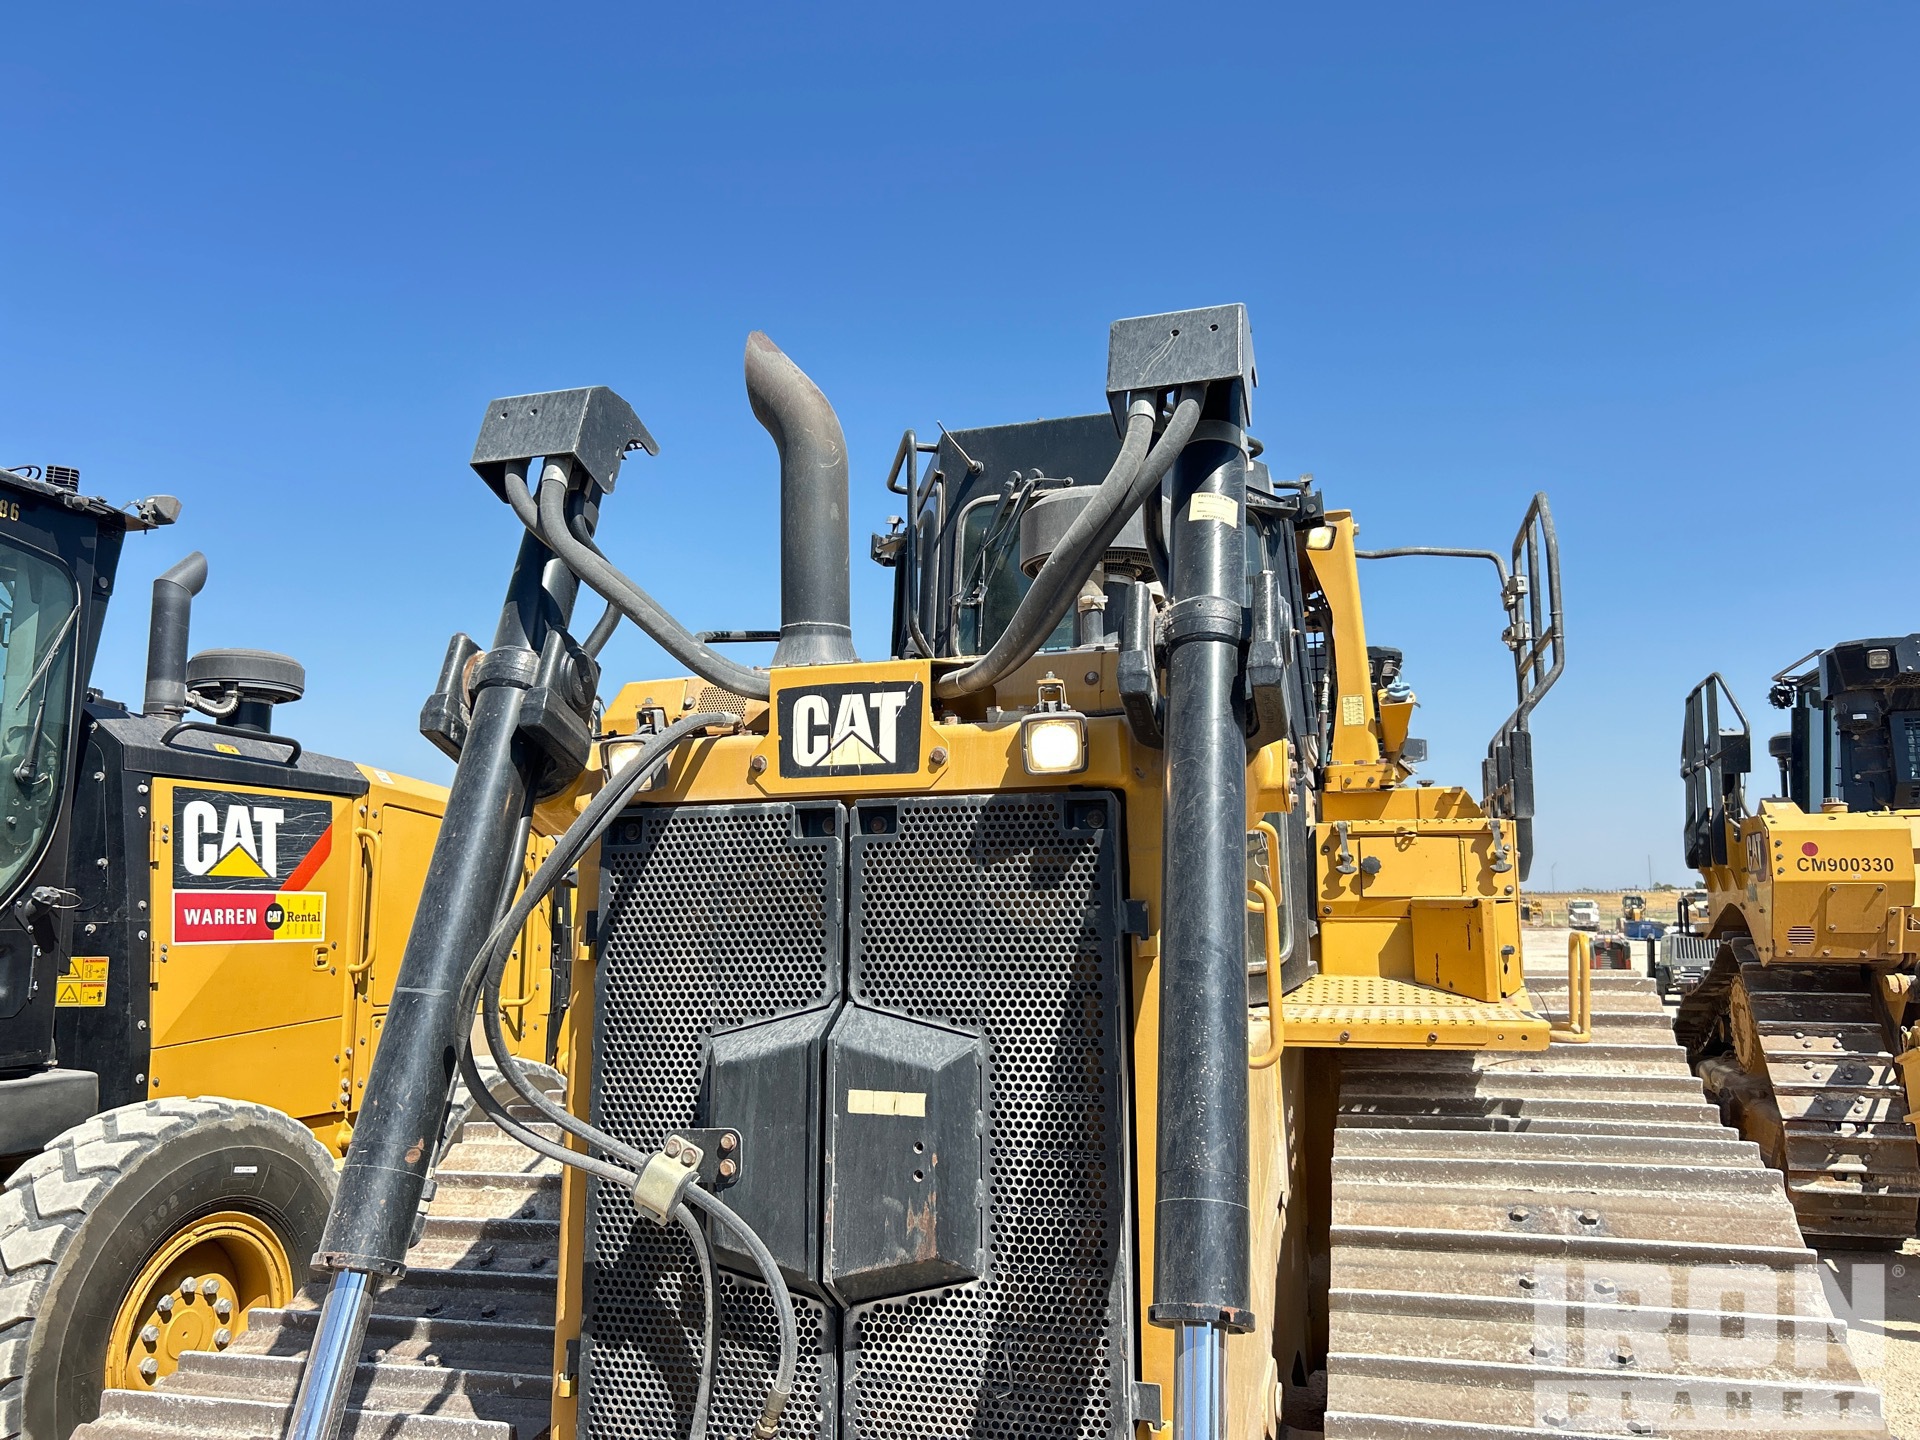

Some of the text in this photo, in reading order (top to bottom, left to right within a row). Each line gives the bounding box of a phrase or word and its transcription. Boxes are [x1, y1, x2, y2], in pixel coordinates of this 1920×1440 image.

[792, 691, 907, 767] CAT
[183, 800, 285, 878] CAT
[1746, 833, 1762, 872] CAT
[1796, 857, 1894, 873] CM900330
[184, 908, 257, 925] WARREN
[267, 910, 282, 923] CAT
[286, 911, 321, 922] Rental
